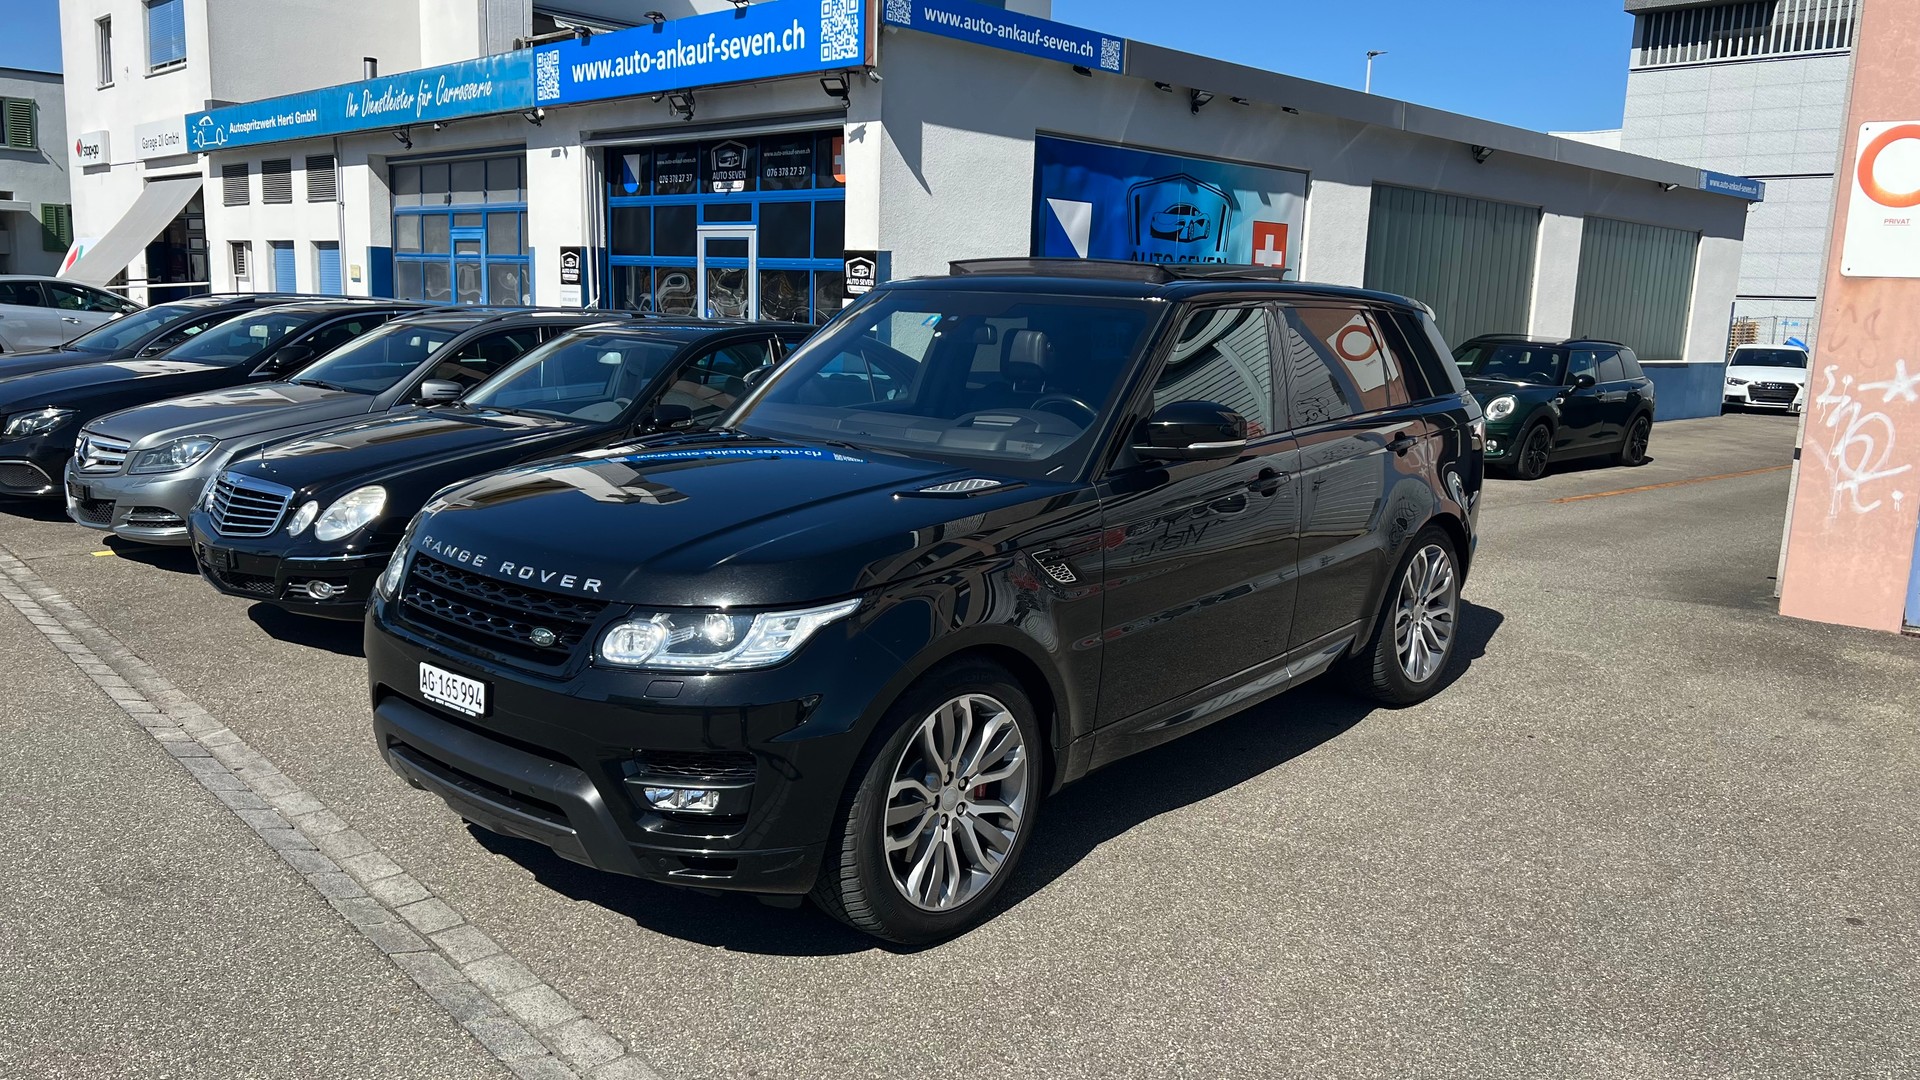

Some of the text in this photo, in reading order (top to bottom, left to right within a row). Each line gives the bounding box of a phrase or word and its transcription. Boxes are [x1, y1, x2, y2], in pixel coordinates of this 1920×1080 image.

[924, 7, 1093, 57] www.auto-ankauf-seven.ch
[571, 19, 805, 83] www.auto-ankauf-seven.ch
[345, 74, 493, 118] Ihr Dienstleister für Carrosserie
[229, 108, 317, 134] Autospritzwerk Herti GmbH
[141, 136, 158, 151] Garage
[164, 131, 180, 146] GmbH
[763, 148, 811, 157] www.auto-ankauf-seven.ch
[658, 173, 693, 184] 076 378 27 37
[712, 170, 746, 181] AUTO SEVEN
[766, 166, 806, 177] 076 378 27 37
[421, 535, 602, 593] RANGE ROVER
